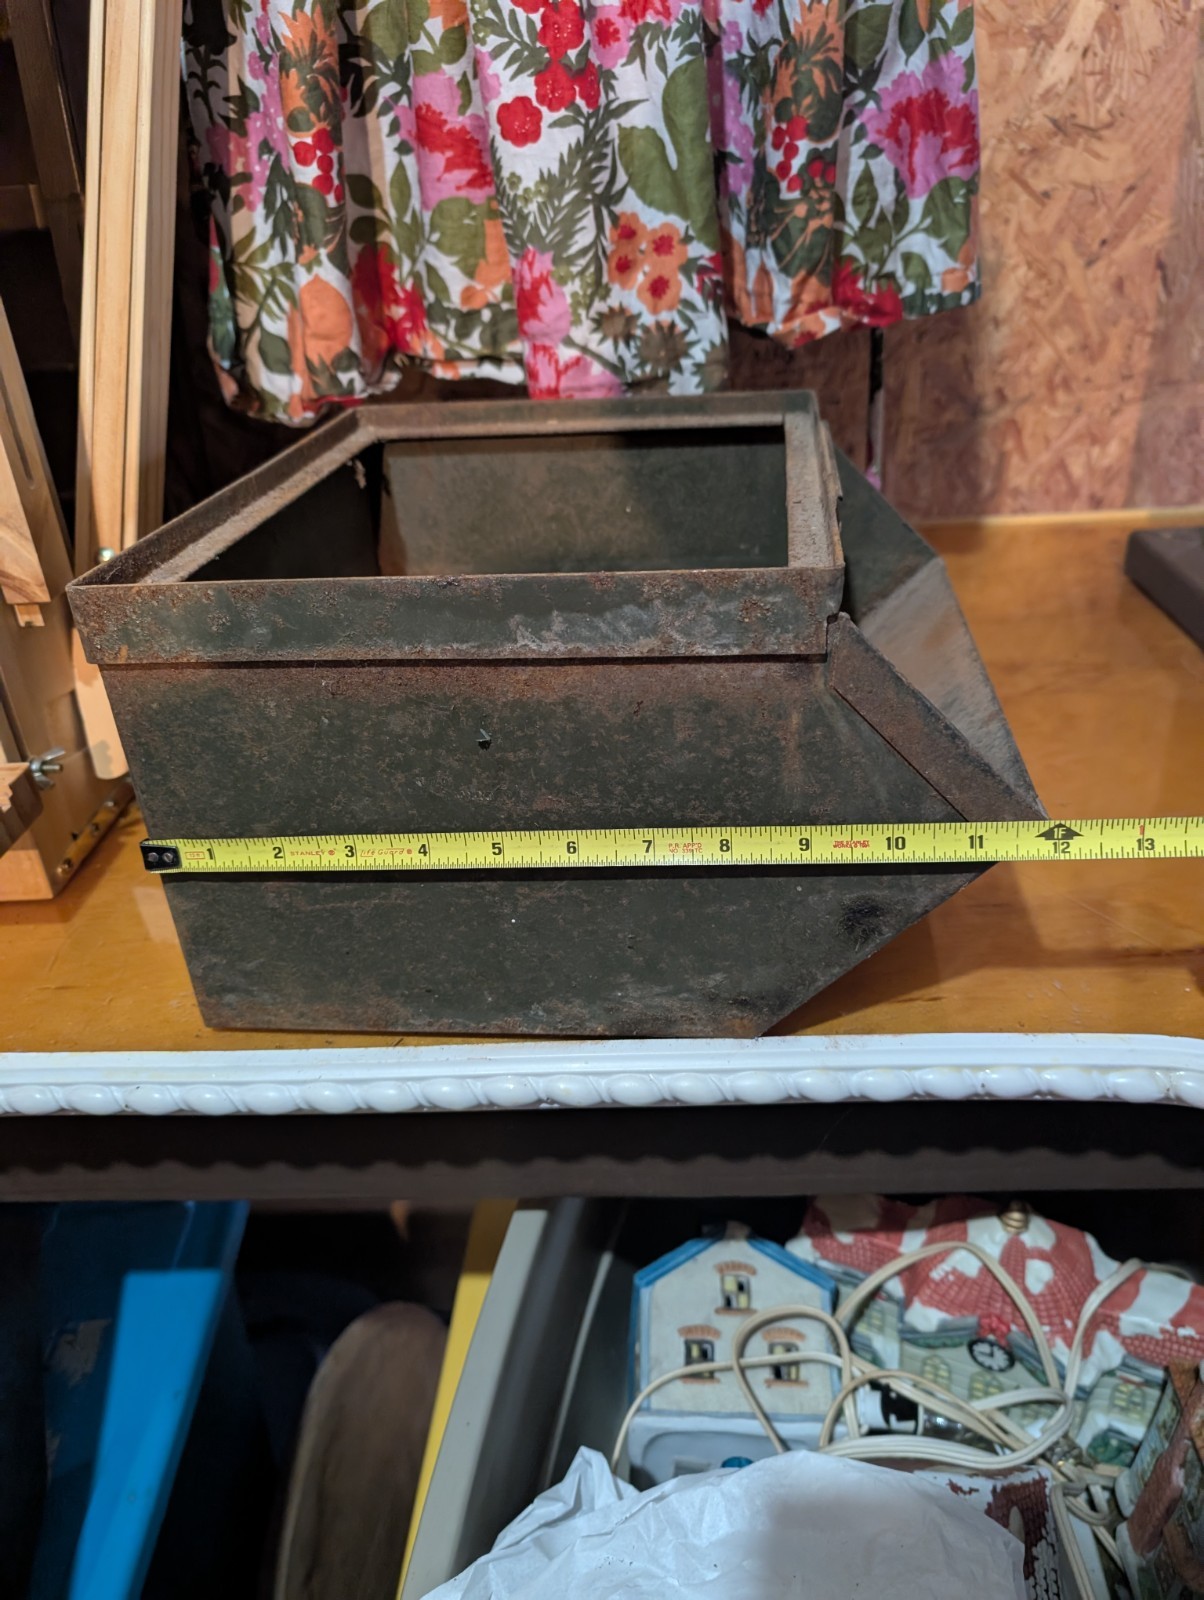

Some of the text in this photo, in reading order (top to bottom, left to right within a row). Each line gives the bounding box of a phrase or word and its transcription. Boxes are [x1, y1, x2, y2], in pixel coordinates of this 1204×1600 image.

[1053, 826, 1068, 839] 1F
[566, 841, 577, 854] 6
[642, 839, 653, 854] 7
[719, 838, 730, 852] 8
[798, 837, 810, 851] 9
[885, 836, 906, 850] 10
[968, 834, 984, 849] 11
[1052, 841, 1071, 854] 12
[1136, 838, 1155, 851] 13
[207, 848, 213, 860] 1
[272, 846, 283, 859] 2
[344, 845, 355, 858] 3
[418, 844, 428, 857] 4
[491, 842, 502, 856] 5
